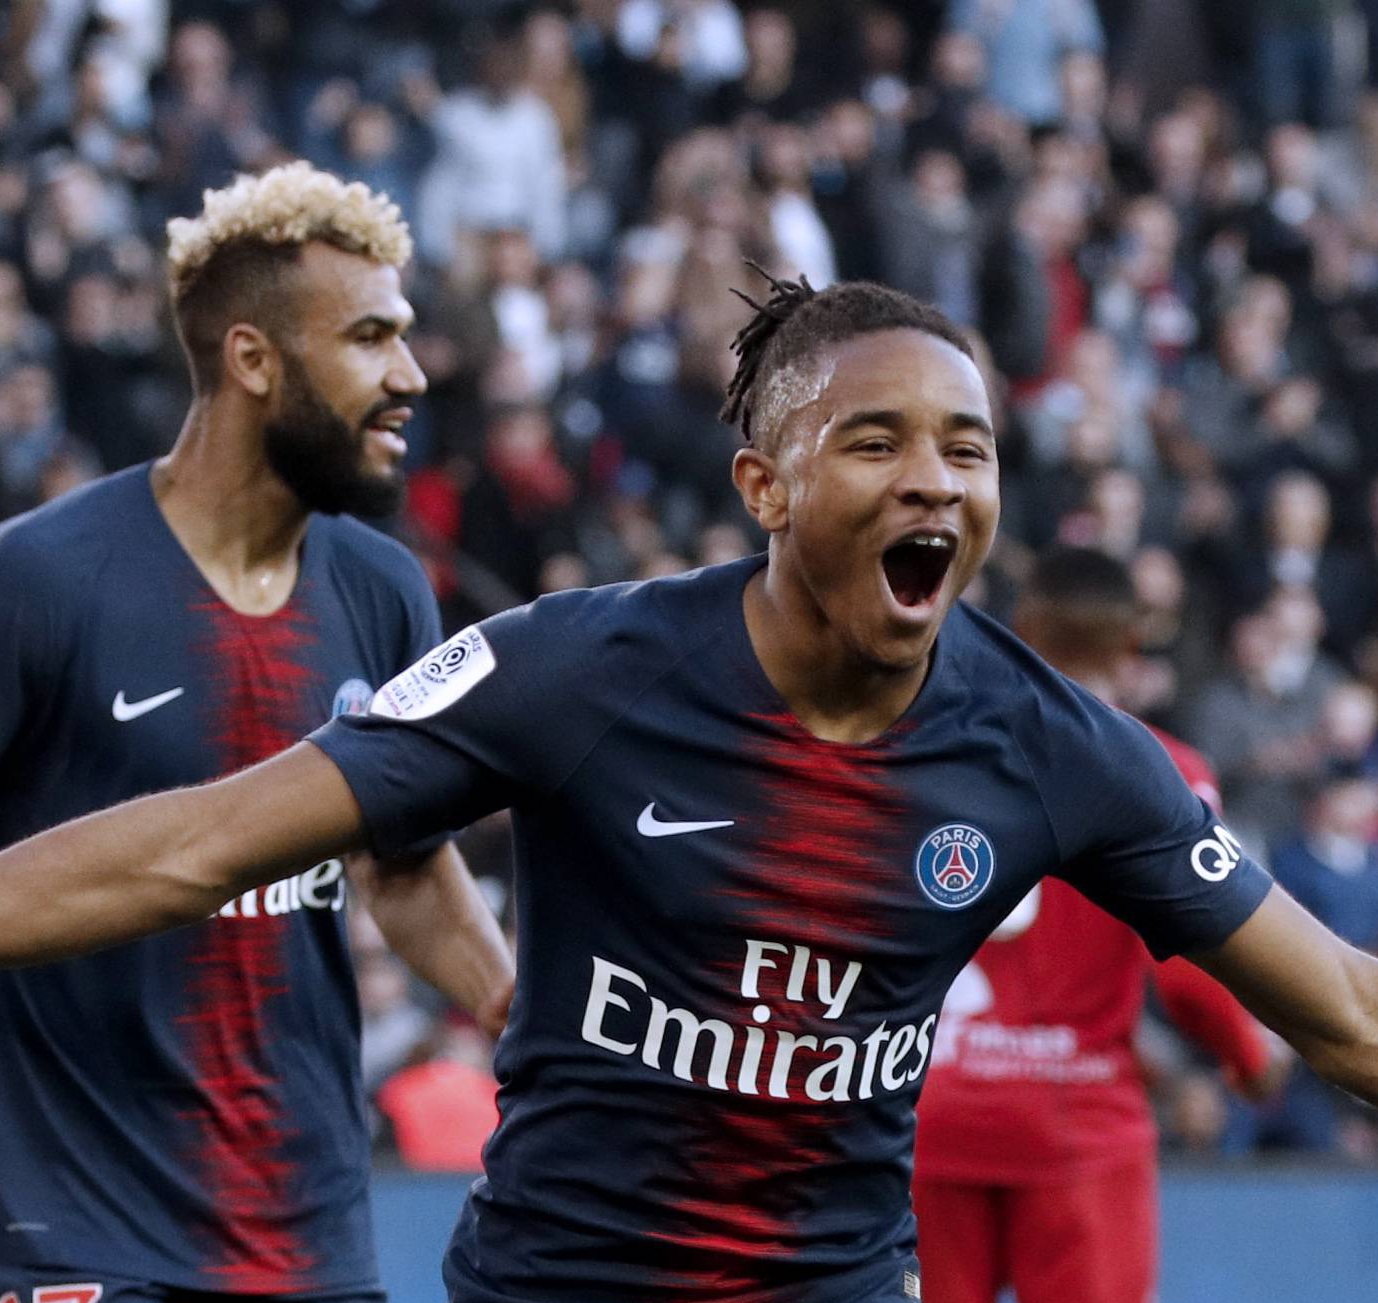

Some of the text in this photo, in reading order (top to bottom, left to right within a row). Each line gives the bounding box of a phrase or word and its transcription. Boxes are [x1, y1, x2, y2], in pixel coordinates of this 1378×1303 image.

[930, 828, 982, 850] PARIS
[741, 938, 863, 1020] Fly
[581, 955, 936, 1102] Emirates
